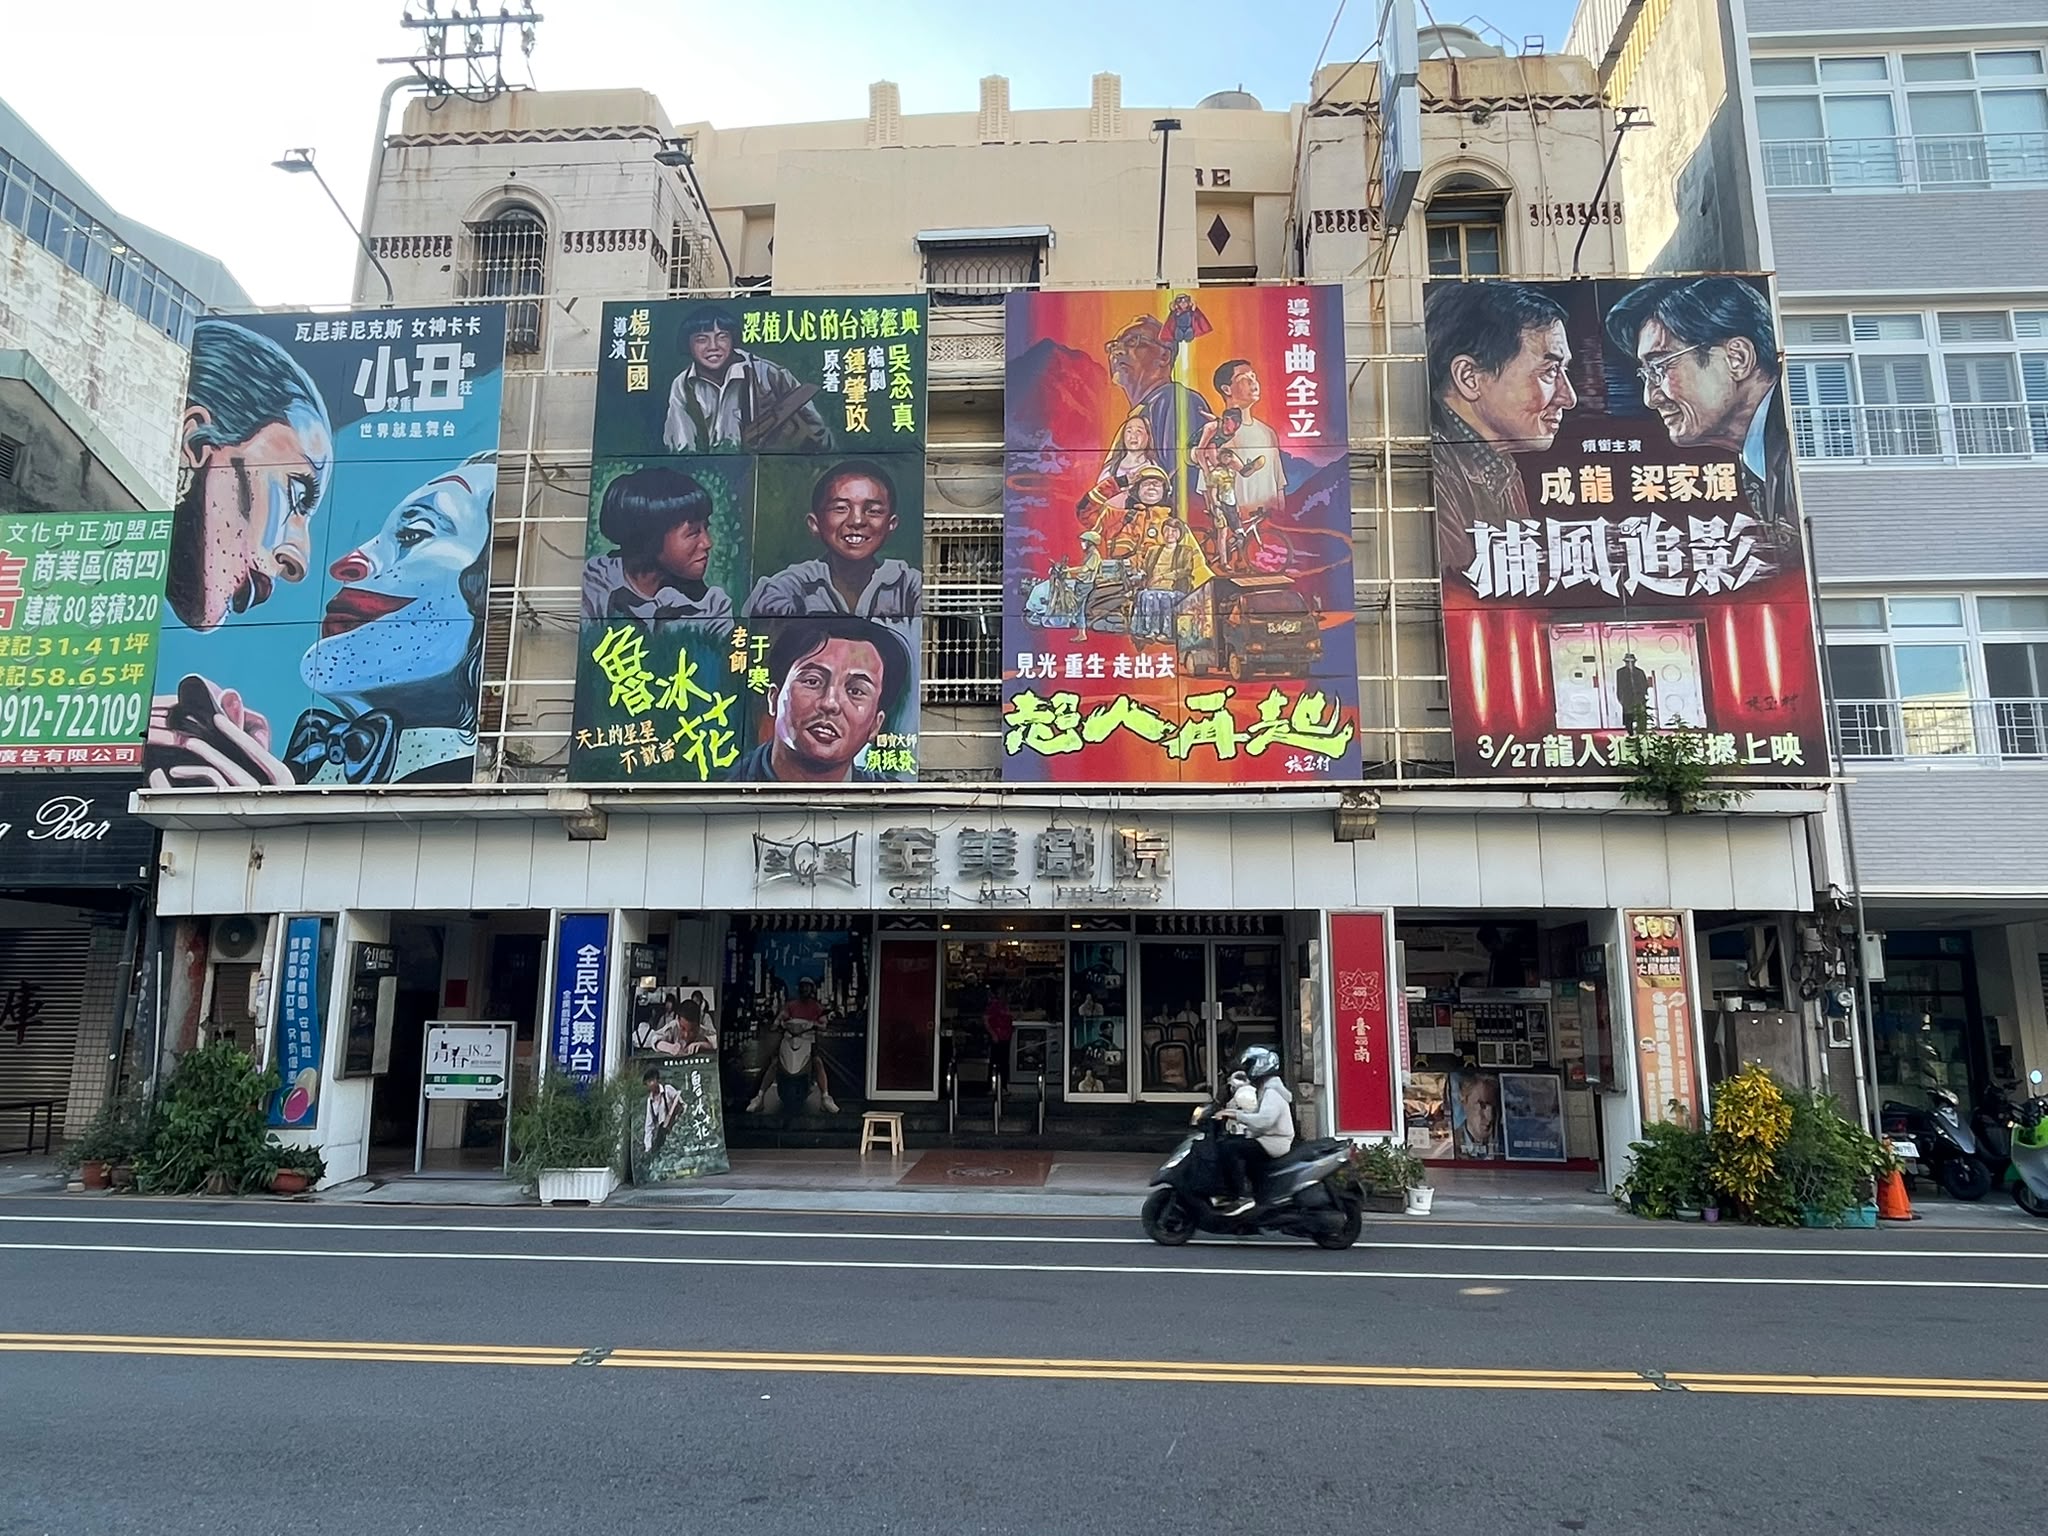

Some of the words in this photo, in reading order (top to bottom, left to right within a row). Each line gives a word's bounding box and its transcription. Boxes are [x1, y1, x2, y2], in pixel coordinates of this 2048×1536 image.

[295, 318, 403, 342] 瓦昆菲尼克斯
[411, 316, 481, 338] 女神卡卡
[608, 316, 628, 360] 導演
[742, 307, 921, 344] 深植人心的台灣經典
[1286, 298, 1311, 337] 導演
[628, 308, 650, 393] 楊立國
[822, 349, 841, 393] 原著
[867, 345, 887, 392] 編劇
[353, 343, 464, 413] 小丑
[1284, 344, 1322, 438] 曲全立
[360, 421, 456, 438] 世界就是舞台
[1540, 464, 1614, 505] 成龍
[1632, 462, 1739, 502] 梁家輝
[6, 519, 171, 543] 文化中正加盟店
[32, 550, 166, 581] 商業區(商四)
[1461, 512, 1768, 599] 捕風追影
[23, 594, 62, 626] 建蔽
[63, 595, 86, 623] 80
[729, 626, 748, 674] 老師
[1016, 653, 1057, 679] 見光
[1065, 653, 1105, 679] 重生
[1113, 653, 1175, 679] 走出去
[592, 625, 740, 781] 魯冰花
[575, 719, 660, 752] 天上的星星
[619, 738, 676, 774] 不說話
[27, 795, 111, 840] Bar
[878, 825, 1171, 880] 全美劇院
[571, 944, 601, 1072] 全民大舞台
